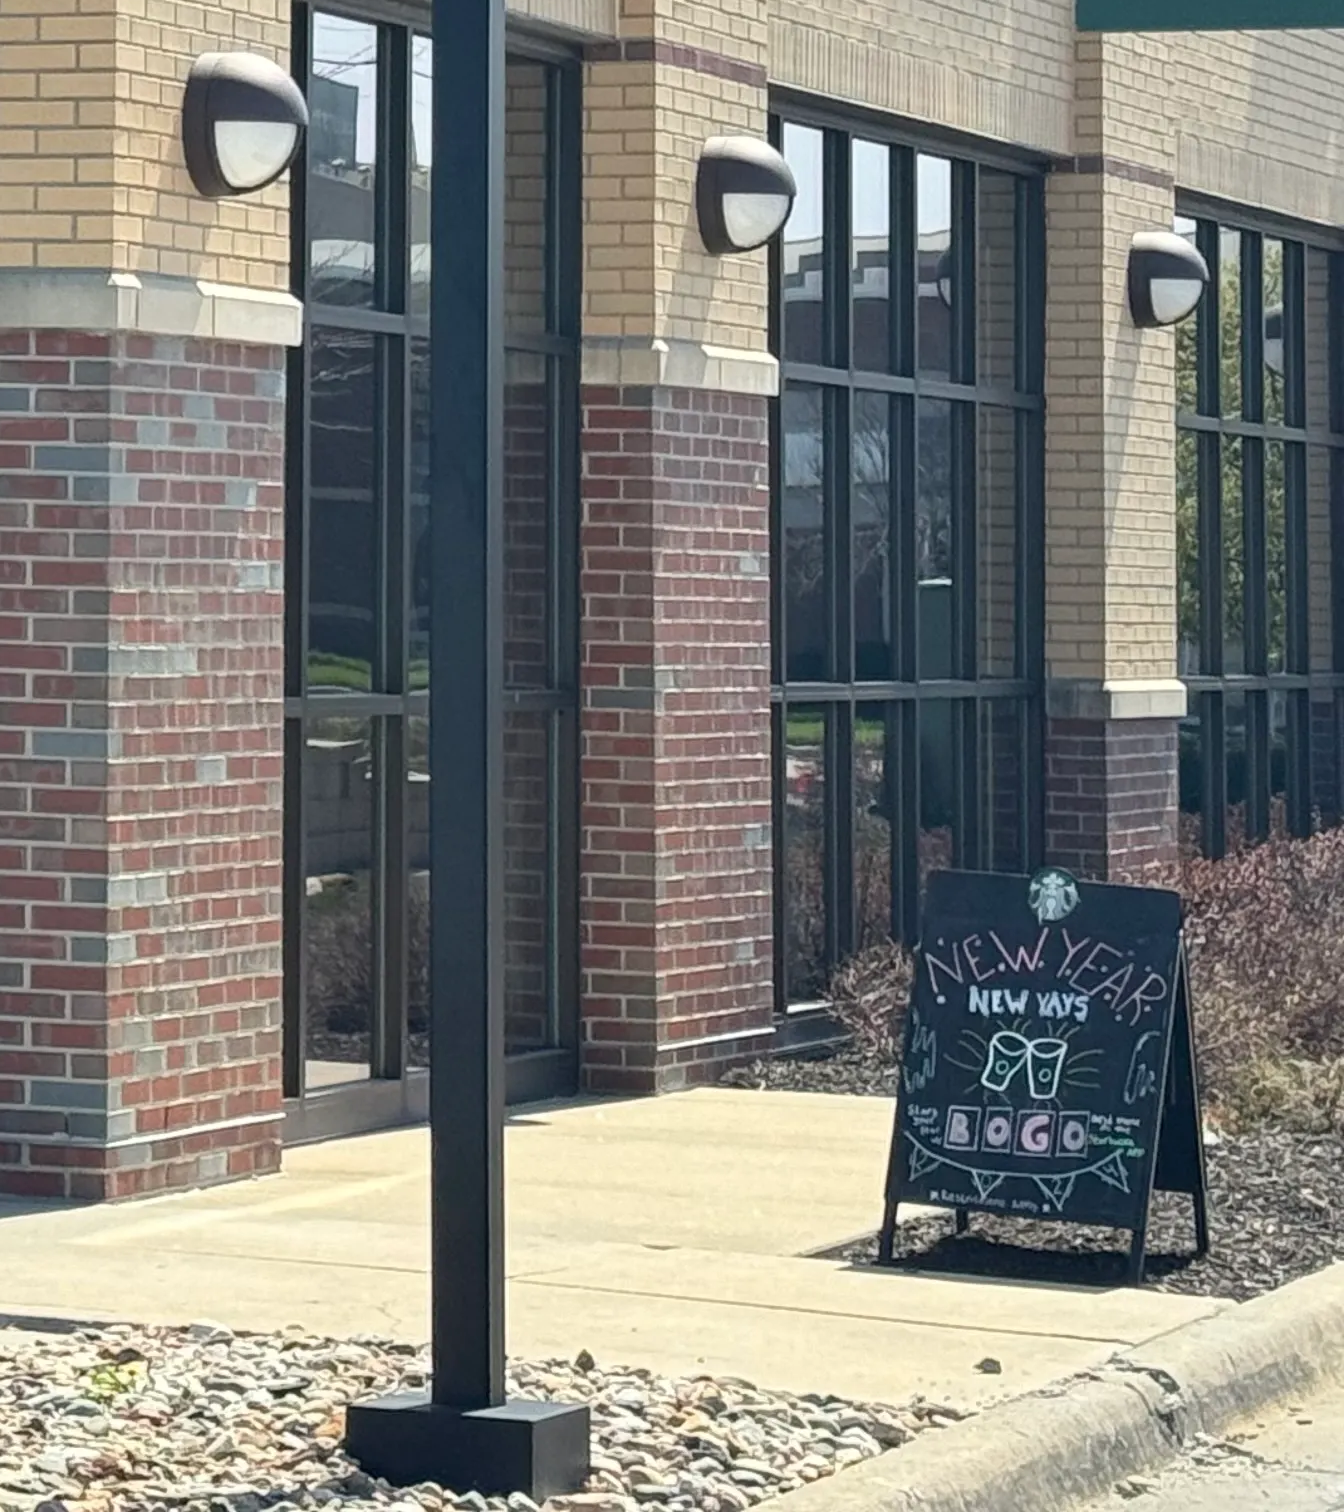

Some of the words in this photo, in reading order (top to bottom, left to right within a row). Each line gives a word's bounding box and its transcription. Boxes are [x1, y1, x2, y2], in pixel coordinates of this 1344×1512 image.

[925, 927, 1049, 994] NEW
[1056, 928, 1168, 1027] YEAR
[968, 985, 1030, 1017] NEW
[1035, 990, 1091, 1023] YAYS
[949, 1112, 1086, 1153] BOGO
